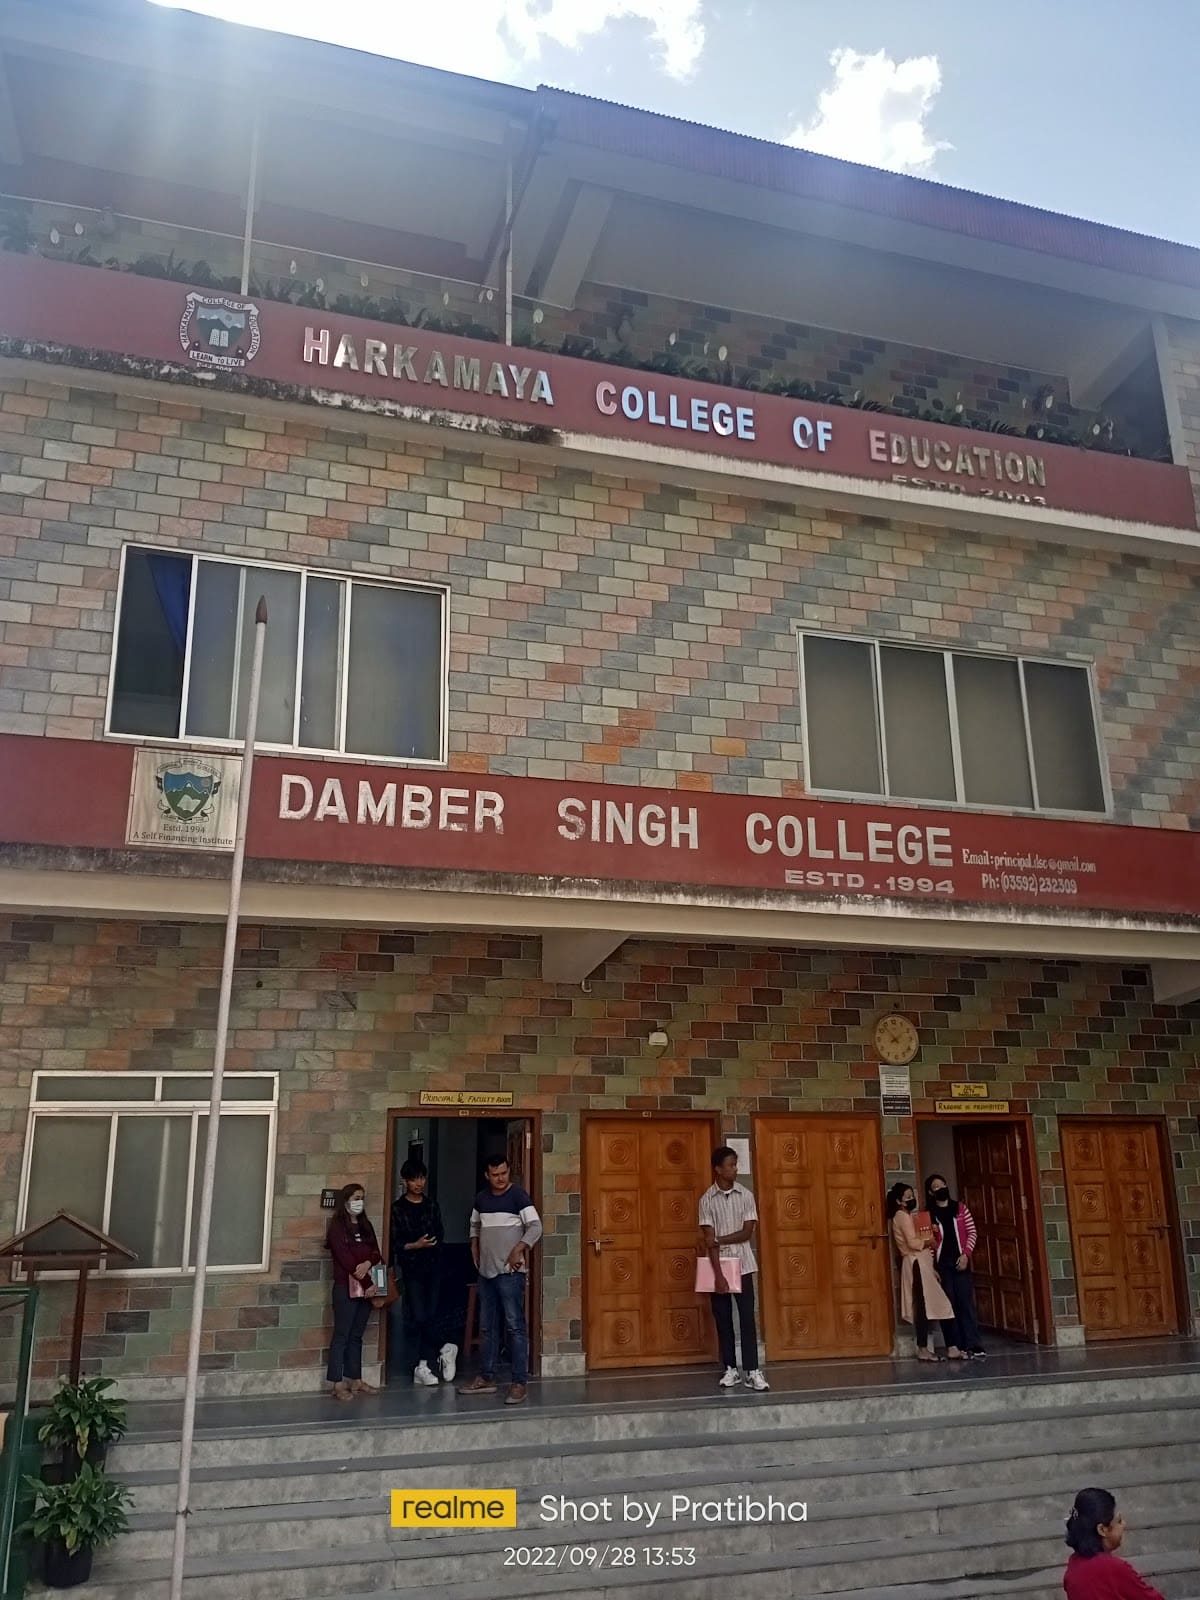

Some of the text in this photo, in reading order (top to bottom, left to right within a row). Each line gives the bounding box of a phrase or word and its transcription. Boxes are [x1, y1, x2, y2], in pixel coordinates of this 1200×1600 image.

[191, 352, 213, 362] LEARN
[303, 326, 1047, 487] HARKAMAYA COLLEGE OF EDUCATION
[279, 774, 953, 867] DAMBER SINGH COLLEGE
[185, 825, 205, 834] 1994
[141, 832, 156, 840] Self
[158, 833, 196, 844] Financing
[199, 836, 233, 845] Institute
[422, 1092, 455, 1103] PRINCIPAL
